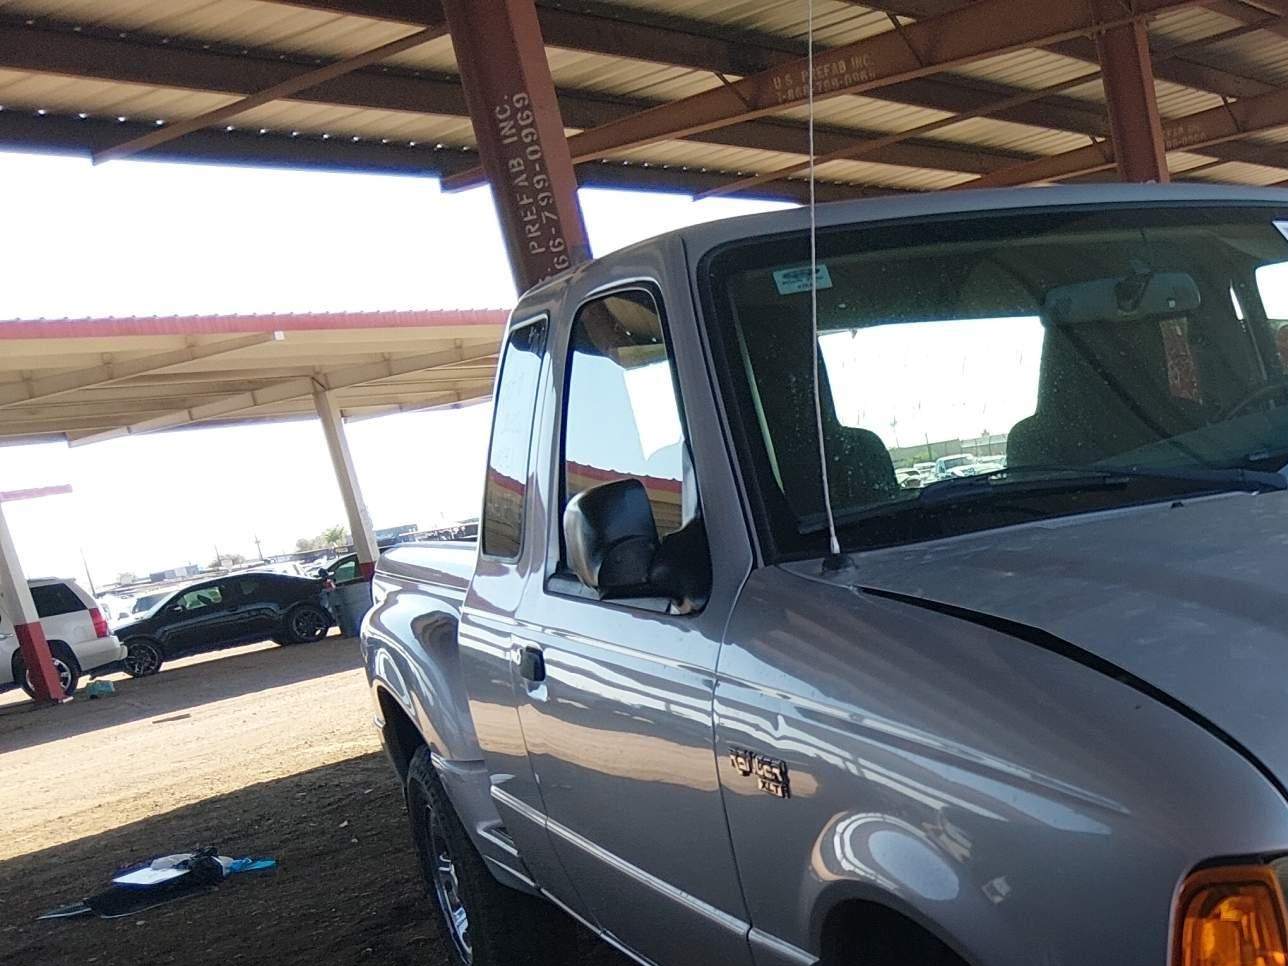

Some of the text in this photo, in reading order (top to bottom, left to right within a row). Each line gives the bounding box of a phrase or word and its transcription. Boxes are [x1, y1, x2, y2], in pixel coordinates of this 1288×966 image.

[495, 95, 518, 144] INC.
[508, 156, 546, 254] PREFAB
[760, 779, 780, 795] XLT
